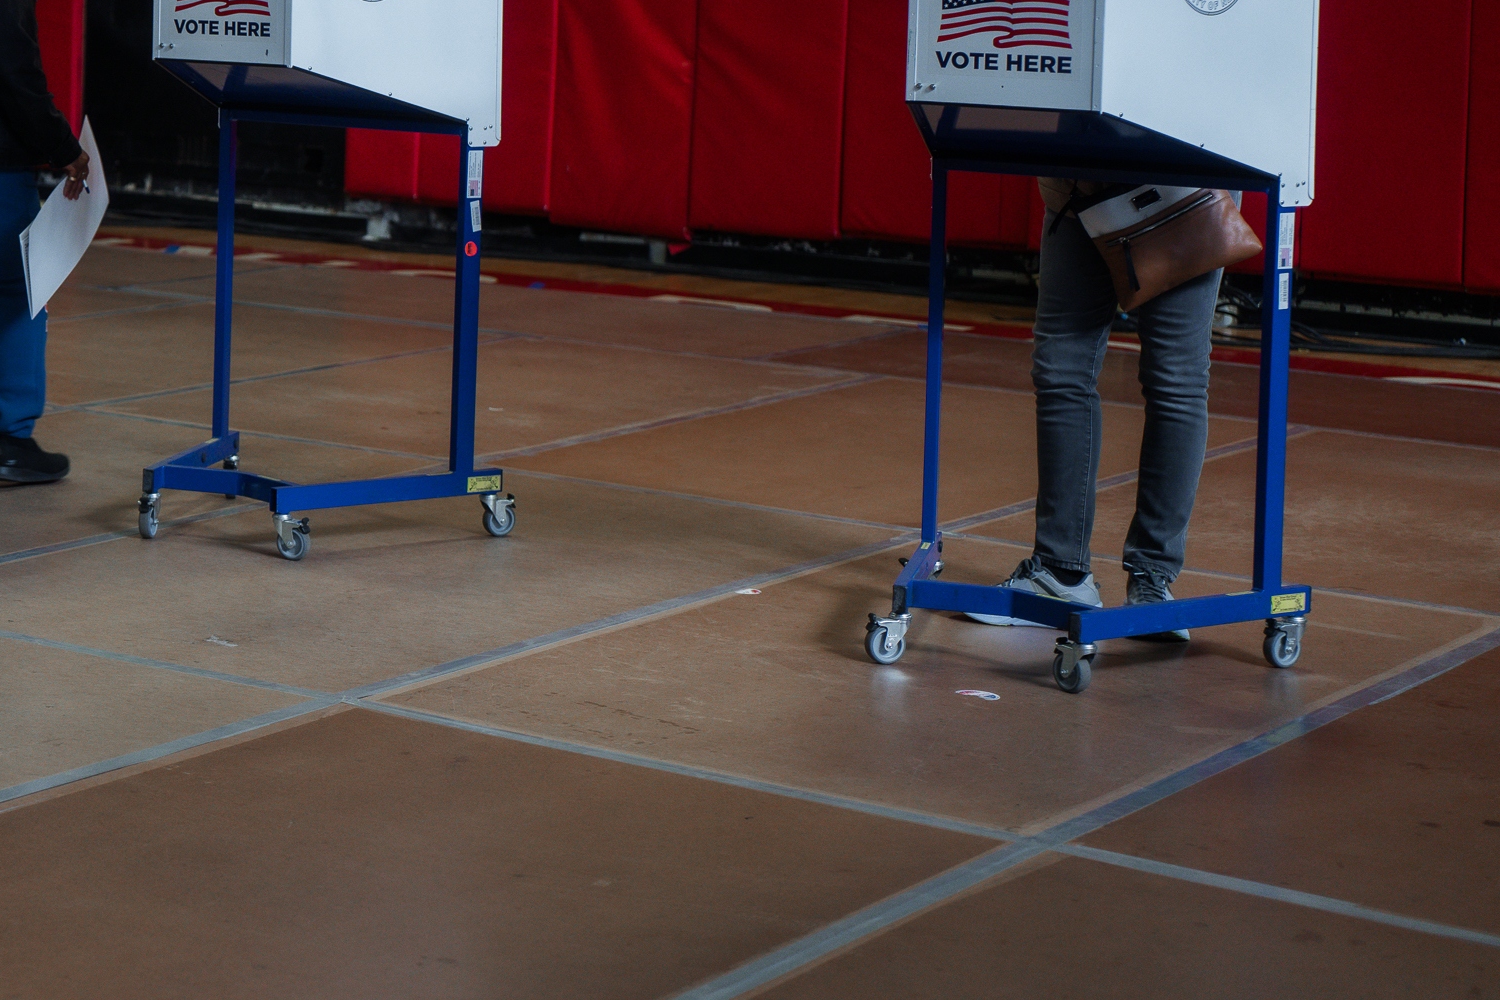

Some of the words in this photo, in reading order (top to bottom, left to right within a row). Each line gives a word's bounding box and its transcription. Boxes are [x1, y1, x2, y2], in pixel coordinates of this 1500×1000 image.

[1208, 0, 1219, 10] OF
[173, 18, 220, 36] VOTE
[225, 20, 271, 38] HERE
[936, 50, 999, 71] VOTE
[1006, 53, 1072, 74] HERE
